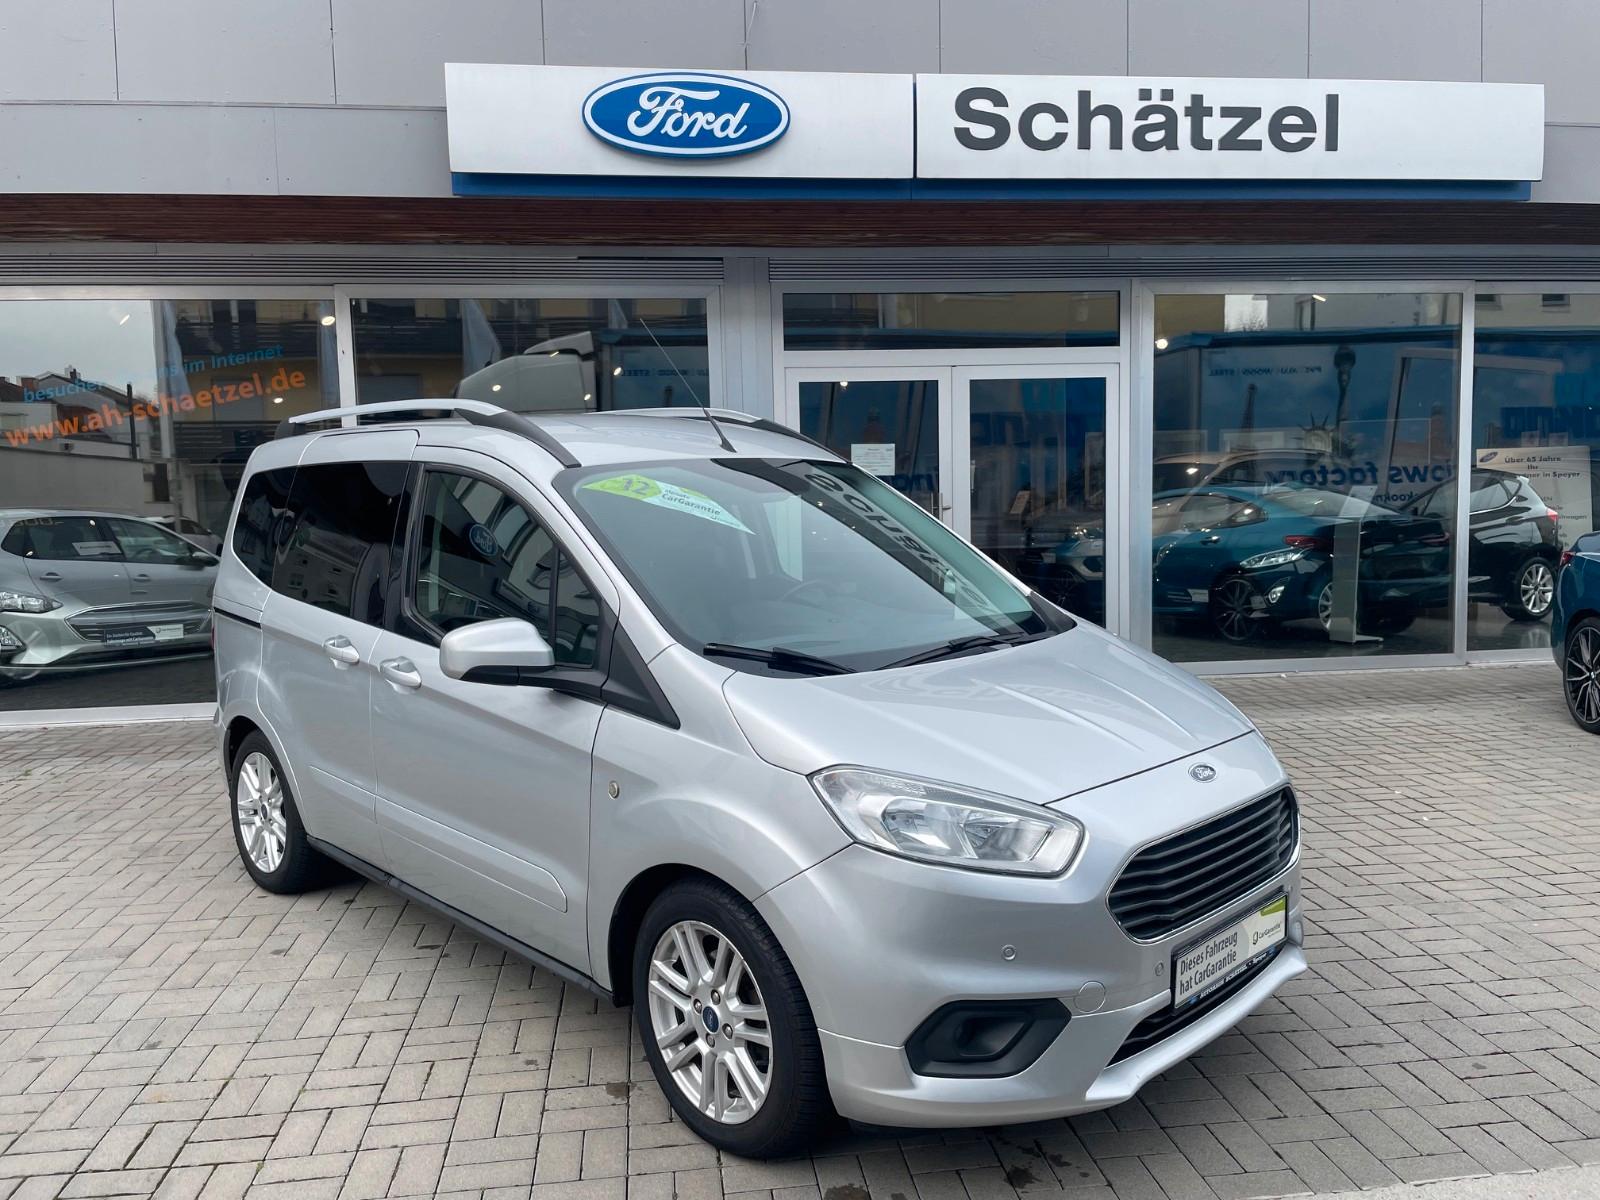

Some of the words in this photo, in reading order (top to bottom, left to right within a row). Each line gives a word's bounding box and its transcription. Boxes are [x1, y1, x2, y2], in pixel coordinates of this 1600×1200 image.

[627, 86, 750, 139] Ford
[953, 86, 1340, 152] Schätzel
[23, 377, 104, 403] besuche
[210, 344, 284, 369] Internet
[5, 367, 306, 448] www.ah-schaetzel.de
[622, 478, 650, 496] 12
[661, 492, 722, 516] CarGarantie
[1180, 951, 1204, 976] Dieses
[1205, 932, 1238, 960] Fahrzeug
[1180, 974, 1193, 996] hat
[1194, 949, 1237, 986] CarGarantie
